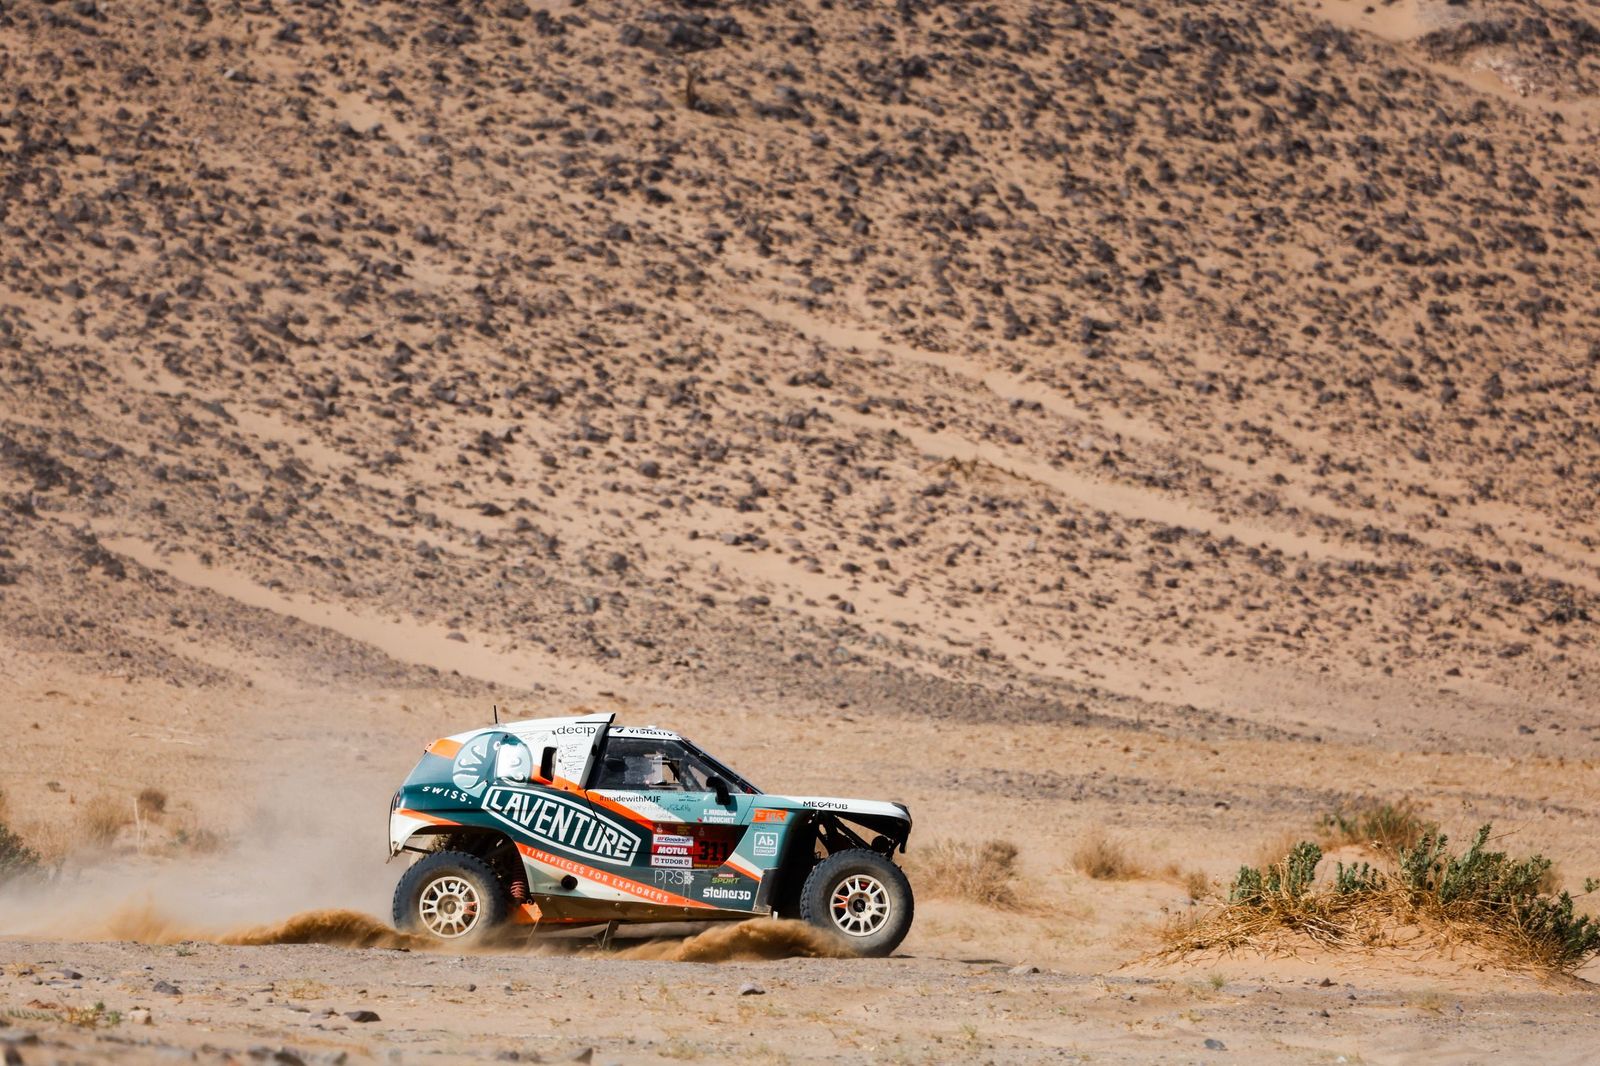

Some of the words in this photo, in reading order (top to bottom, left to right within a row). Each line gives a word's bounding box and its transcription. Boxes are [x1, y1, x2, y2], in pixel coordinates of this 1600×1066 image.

[556, 725, 596, 737] decip
[599, 795, 661, 803] #madewithMJF
[490, 790, 632, 859] LAVENTURE
[757, 835, 774, 847] Ab
[657, 846, 688, 855] MOTUL
[526, 847, 585, 875] TIMEPIECES
[588, 870, 609, 883] FOR
[612, 878, 669, 904] EXPLORERS
